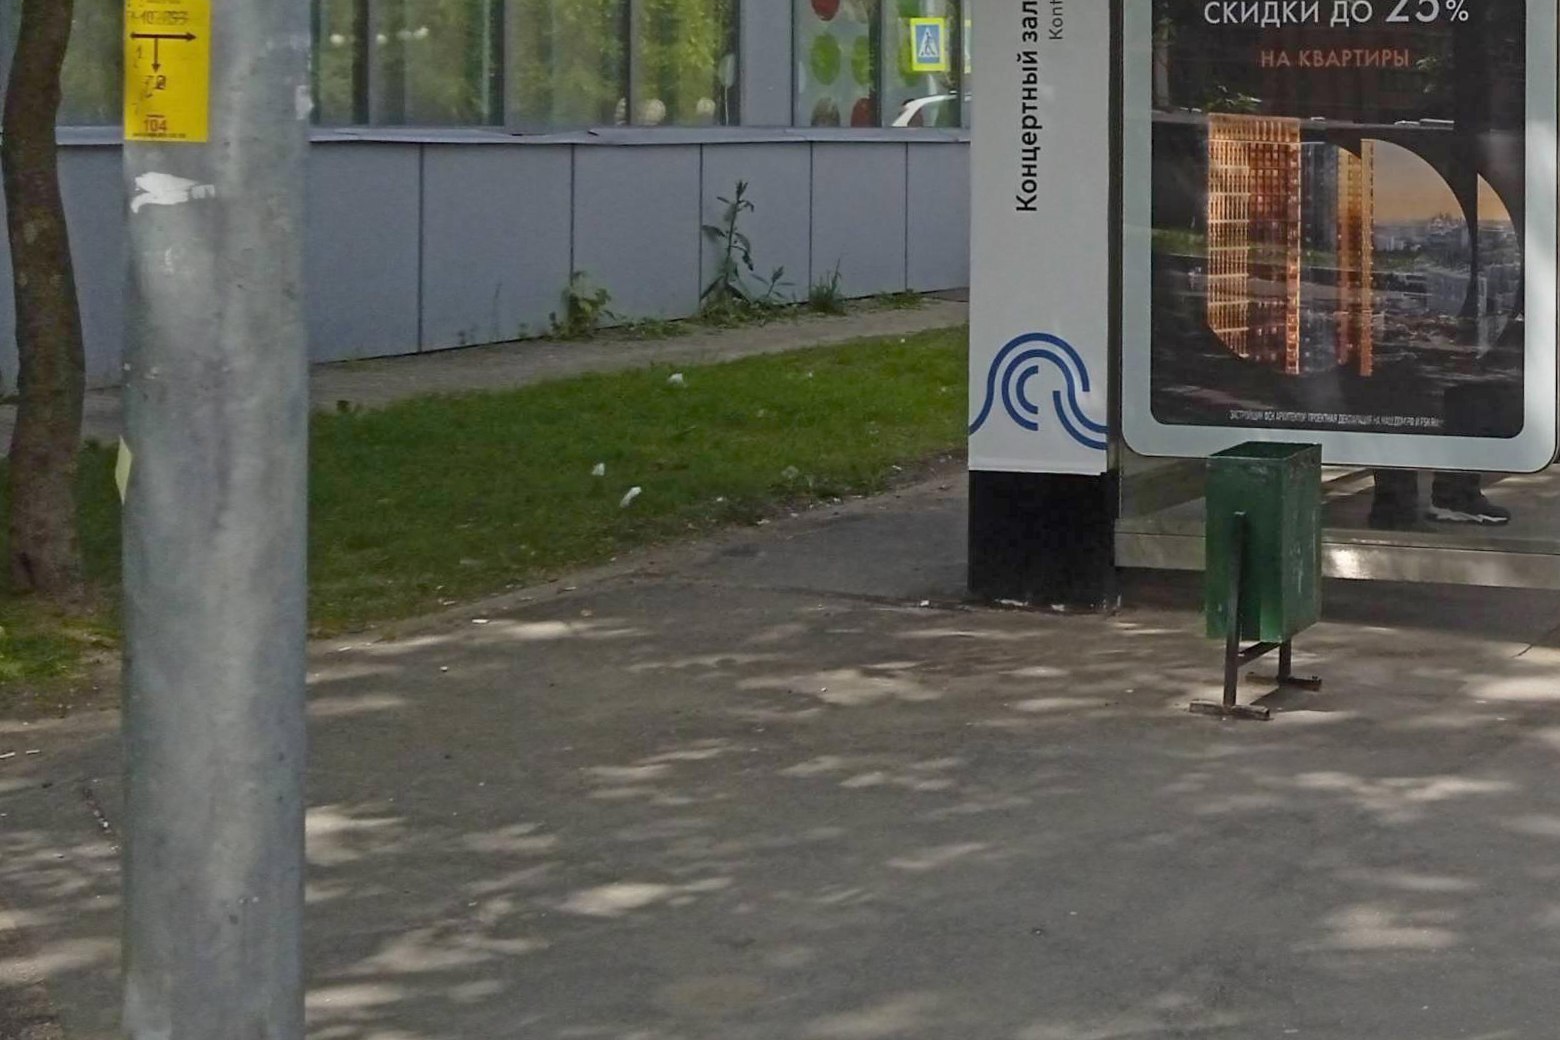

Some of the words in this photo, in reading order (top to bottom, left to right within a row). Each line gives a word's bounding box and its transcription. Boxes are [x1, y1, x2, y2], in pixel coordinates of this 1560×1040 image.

[1021, 0, 1039, 42] зал
[1203, 0, 1320, 28] СКИДКИ
[1330, 0, 1373, 28] ДО
[1260, 50, 1291, 68] НА
[1299, 48, 1410, 68] КВАРТИРЫ
[1016, 52, 1043, 212] Концертный
